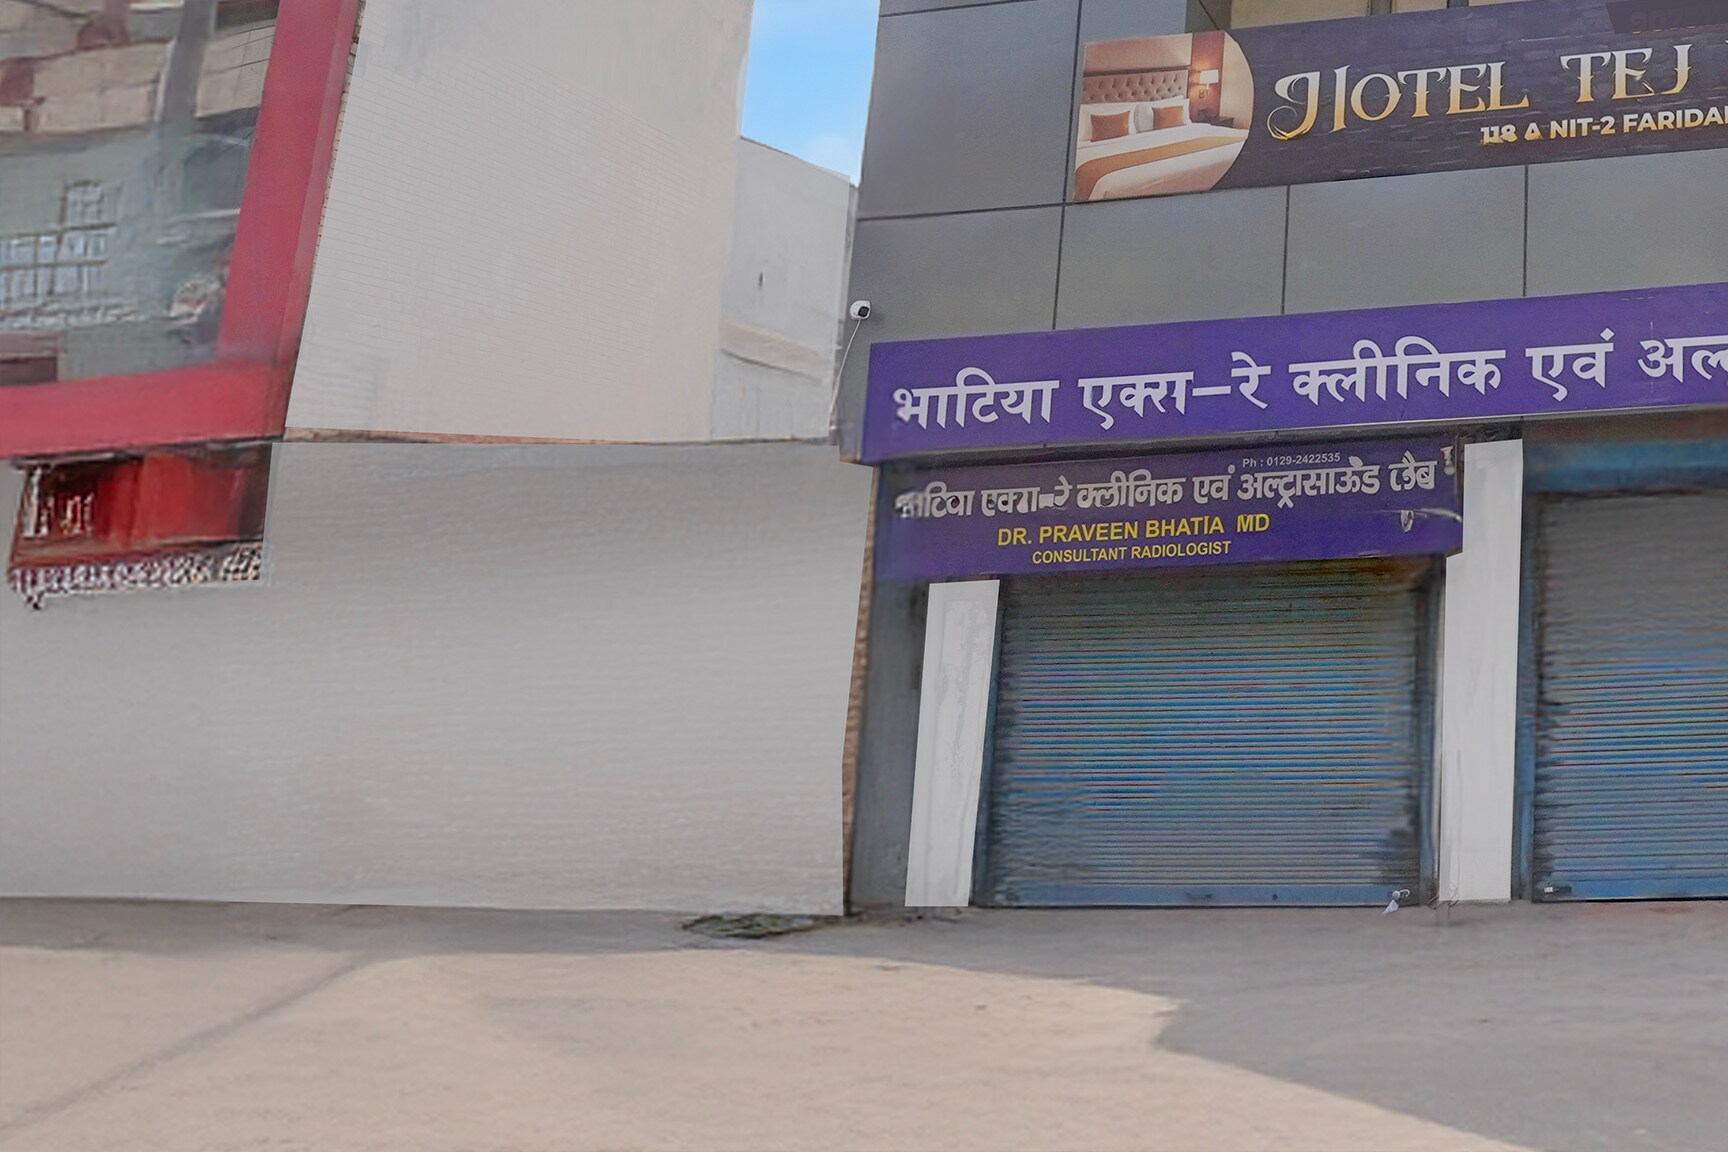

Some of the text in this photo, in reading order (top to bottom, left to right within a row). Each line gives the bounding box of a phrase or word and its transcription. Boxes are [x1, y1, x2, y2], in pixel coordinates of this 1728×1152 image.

[1266, 61, 1530, 140] HOTEL
[1560, 43, 1693, 103] TEJ
[1549, 115, 1616, 140] NIT-2
[892, 367, 1060, 430] भाटिया
[1288, 334, 1506, 406] क्लीनिक
[1525, 328, 1614, 401] एवं
[1242, 457, 1257, 468] Ph
[1266, 452, 1341, 467] 0129-2422535
[1191, 464, 1236, 504] एवं
[997, 513, 1270, 547] DR. PRAVEEN BHATIA MD
[1032, 540, 1232, 565] CONSULTANT RADIOLOGIST
